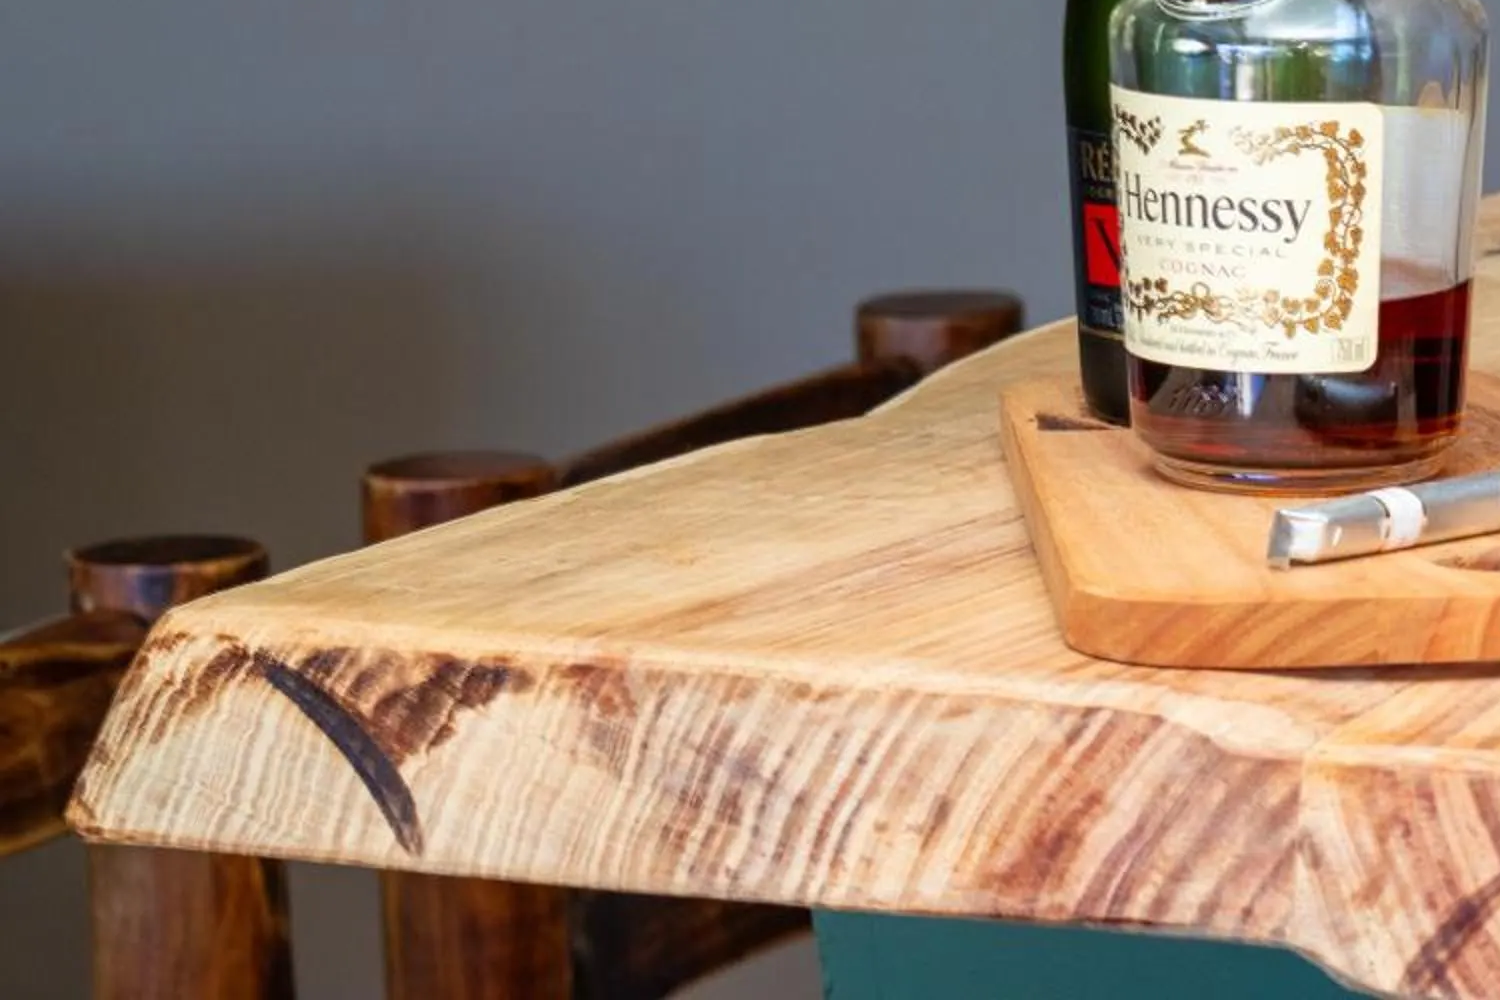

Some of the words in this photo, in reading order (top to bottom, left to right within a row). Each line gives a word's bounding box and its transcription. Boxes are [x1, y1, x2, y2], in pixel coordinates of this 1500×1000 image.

[1079, 140, 1120, 182] RÉ
[1123, 170, 1313, 244] Hennessy
[1136, 235, 1174, 249] VERY
[1185, 241, 1288, 259] SPECIAL
[1159, 258, 1246, 278] COGNAC
